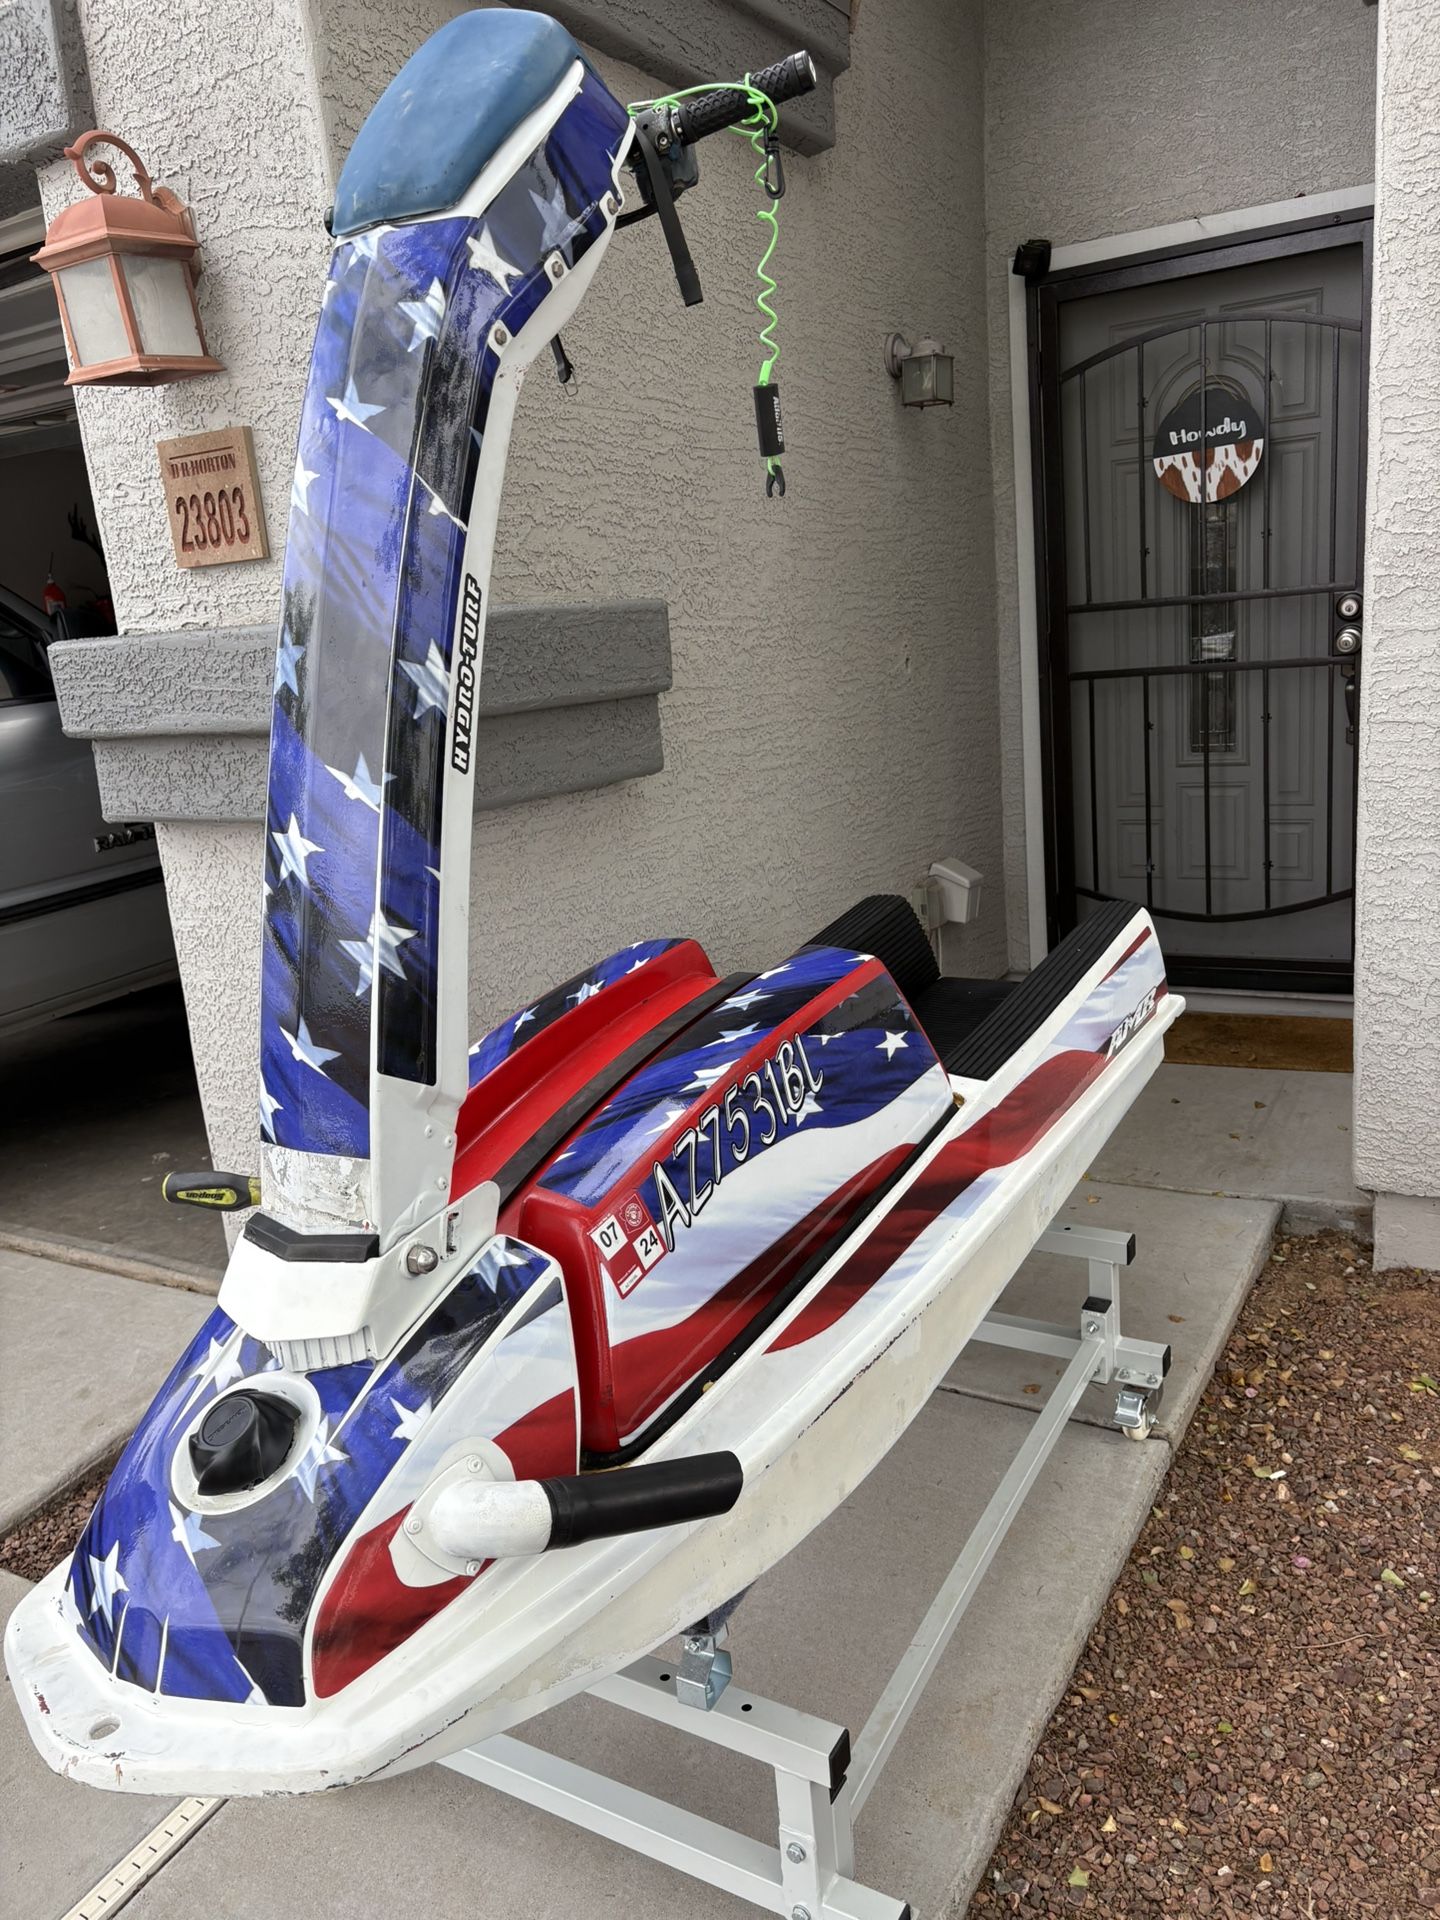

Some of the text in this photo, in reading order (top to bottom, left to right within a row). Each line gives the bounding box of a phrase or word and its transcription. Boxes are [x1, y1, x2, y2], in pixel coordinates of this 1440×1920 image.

[1169, 416, 1247, 445] Howdy
[175, 486, 250, 552] 23803
[452, 573, 482, 775] HYDRO-TURF
[599, 1221, 618, 1248] 07
[640, 1229, 659, 1257] 24
